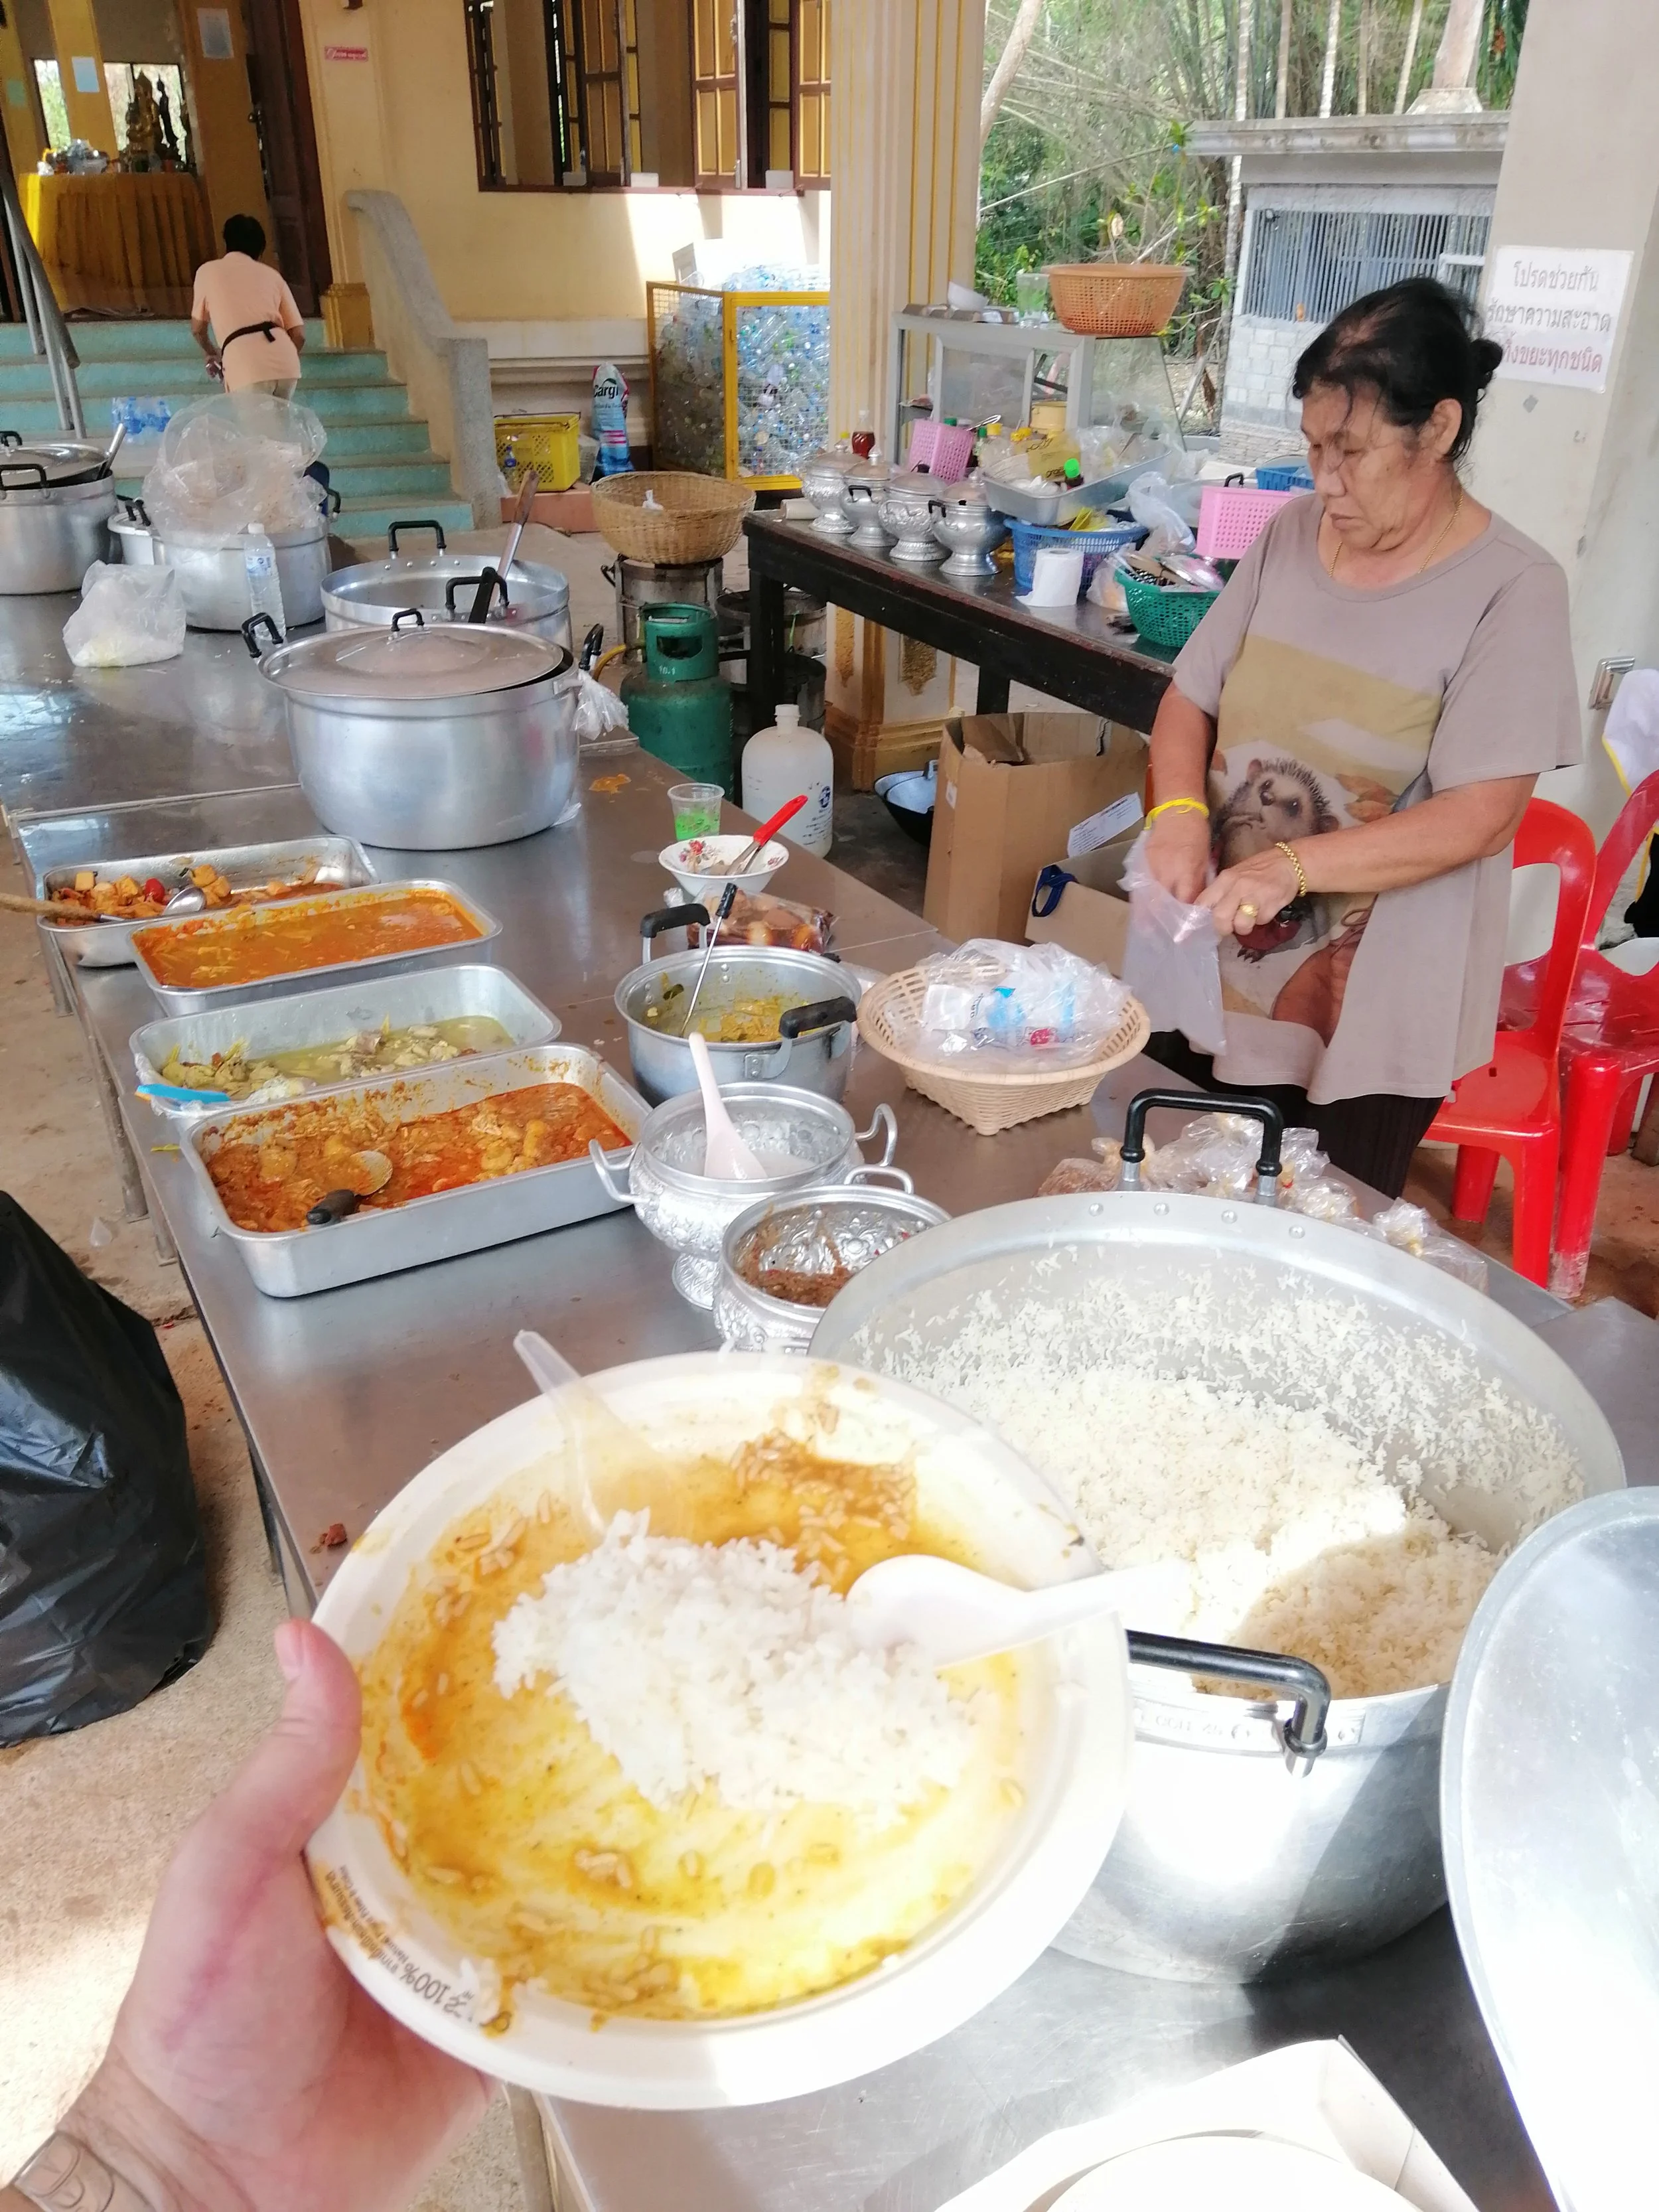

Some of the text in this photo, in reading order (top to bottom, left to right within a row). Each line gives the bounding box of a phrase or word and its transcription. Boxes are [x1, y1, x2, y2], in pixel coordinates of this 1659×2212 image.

[1513, 261, 1599, 291] โปรดช่วยกัน
[399, 1962, 451, 2004] 100%
